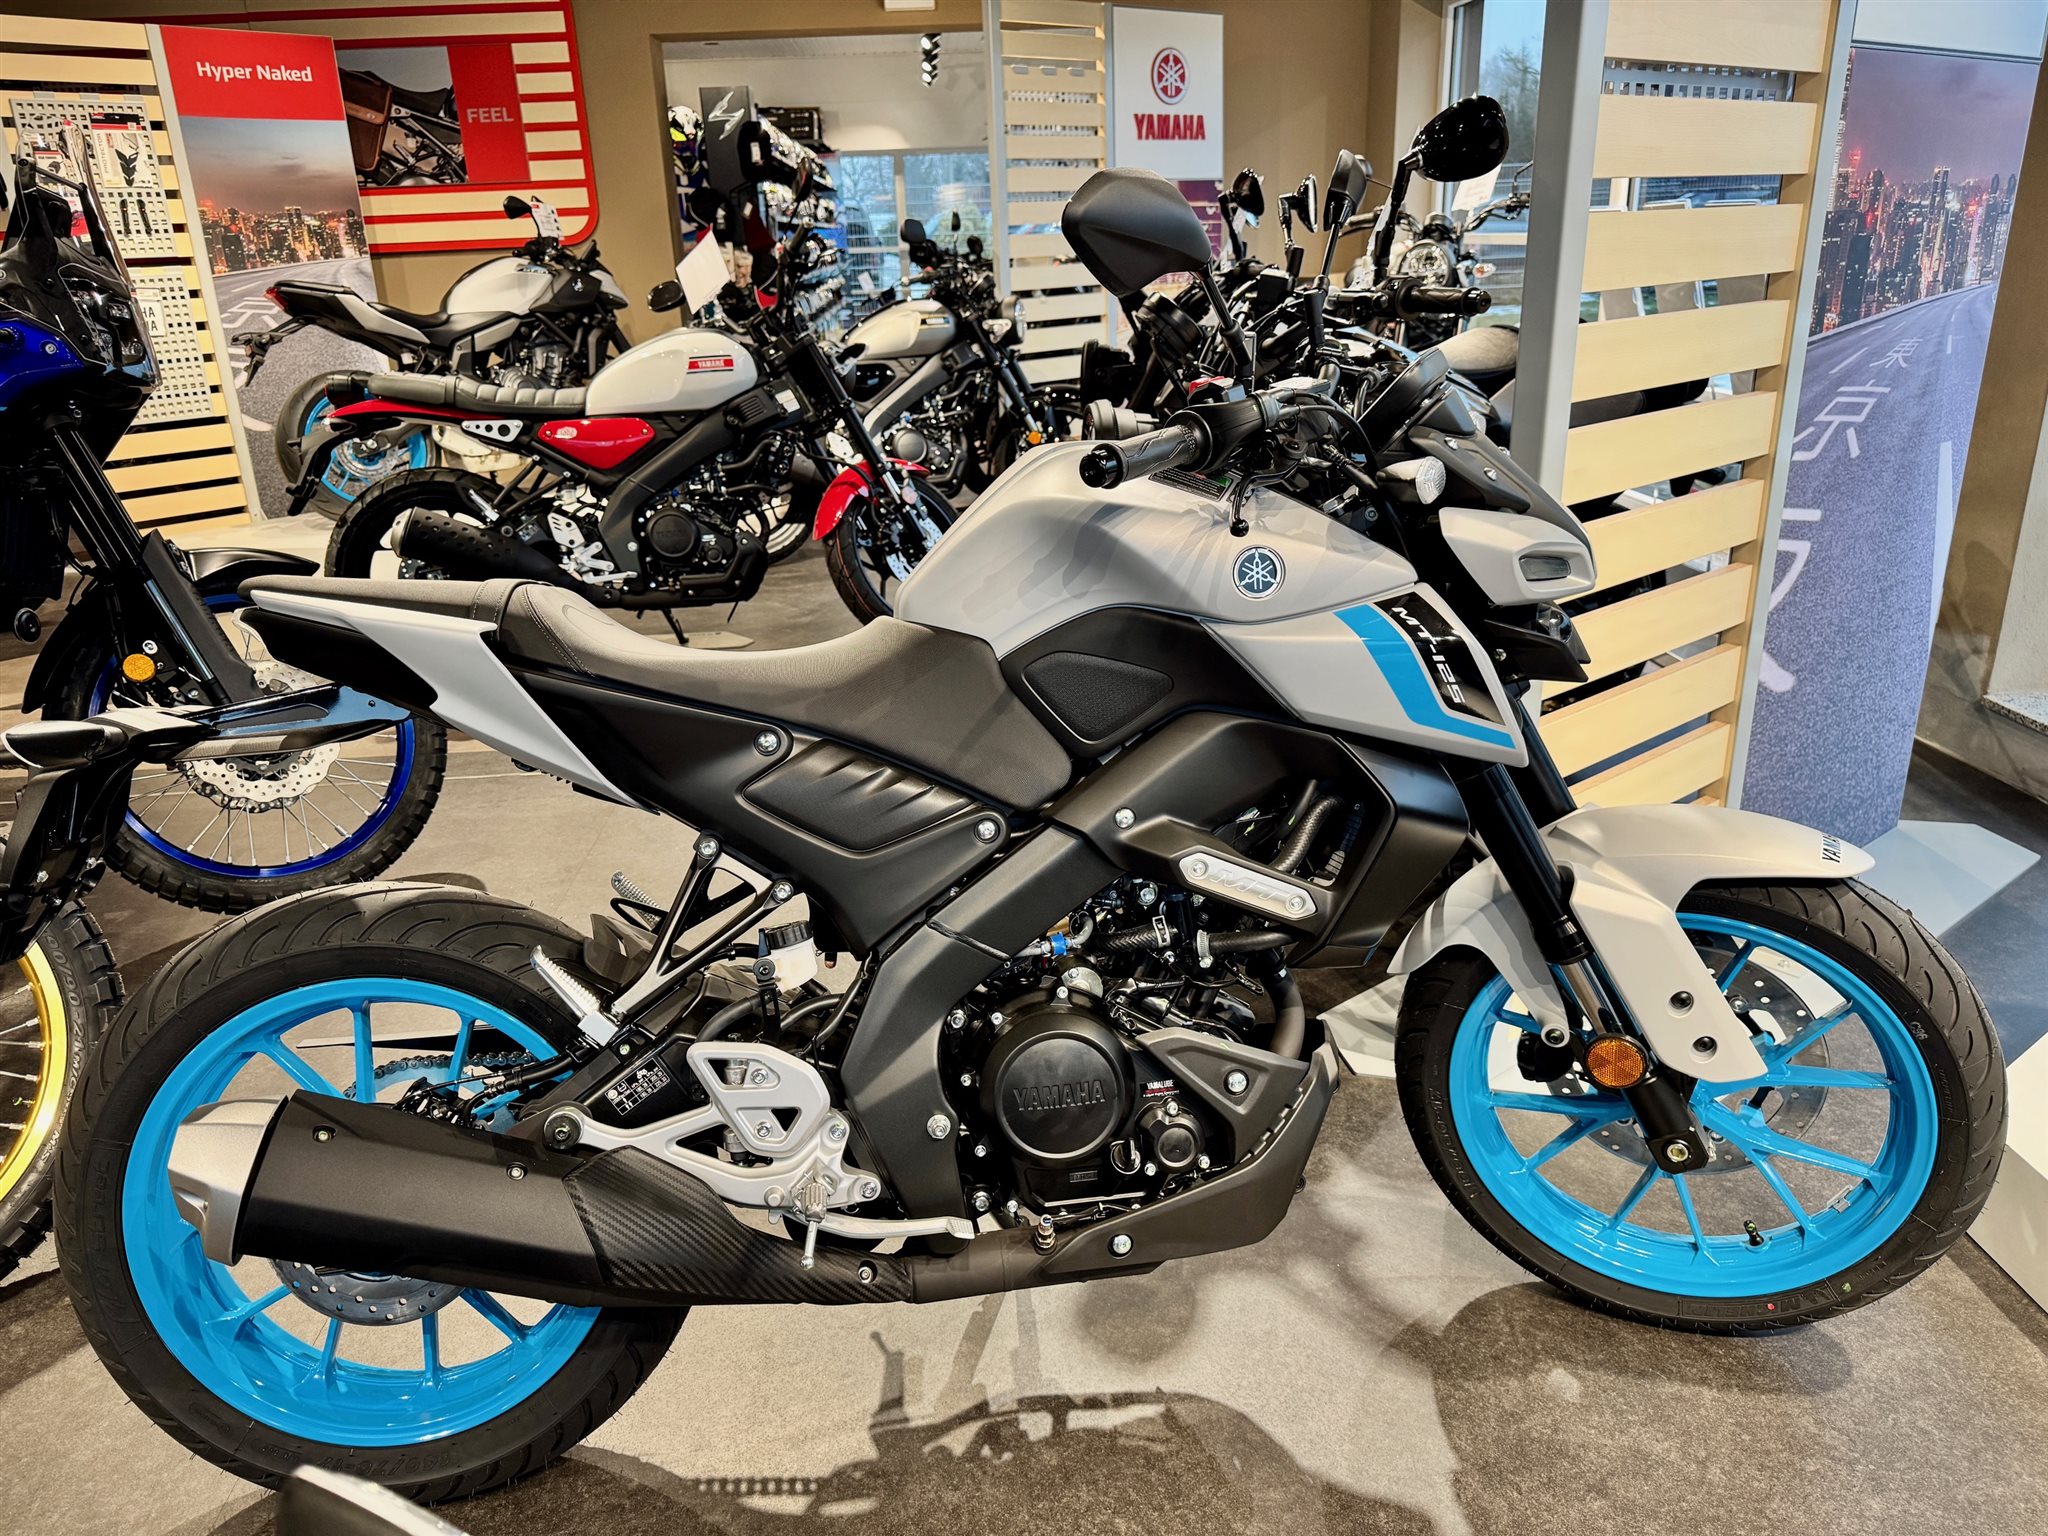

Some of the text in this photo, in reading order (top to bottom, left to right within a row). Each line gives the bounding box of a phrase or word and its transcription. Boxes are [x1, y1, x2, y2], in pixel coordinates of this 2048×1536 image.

[196, 61, 313, 82] Hyper Naked
[466, 107, 514, 123] FEEL
[1133, 113, 1206, 140] YAMAHA
[1391, 607, 1466, 704] MT-125
[1208, 868, 1291, 901] MT
[1013, 1079, 1106, 1111] YAMAHA
[1146, 1079, 1174, 1090] YAMALUBE
